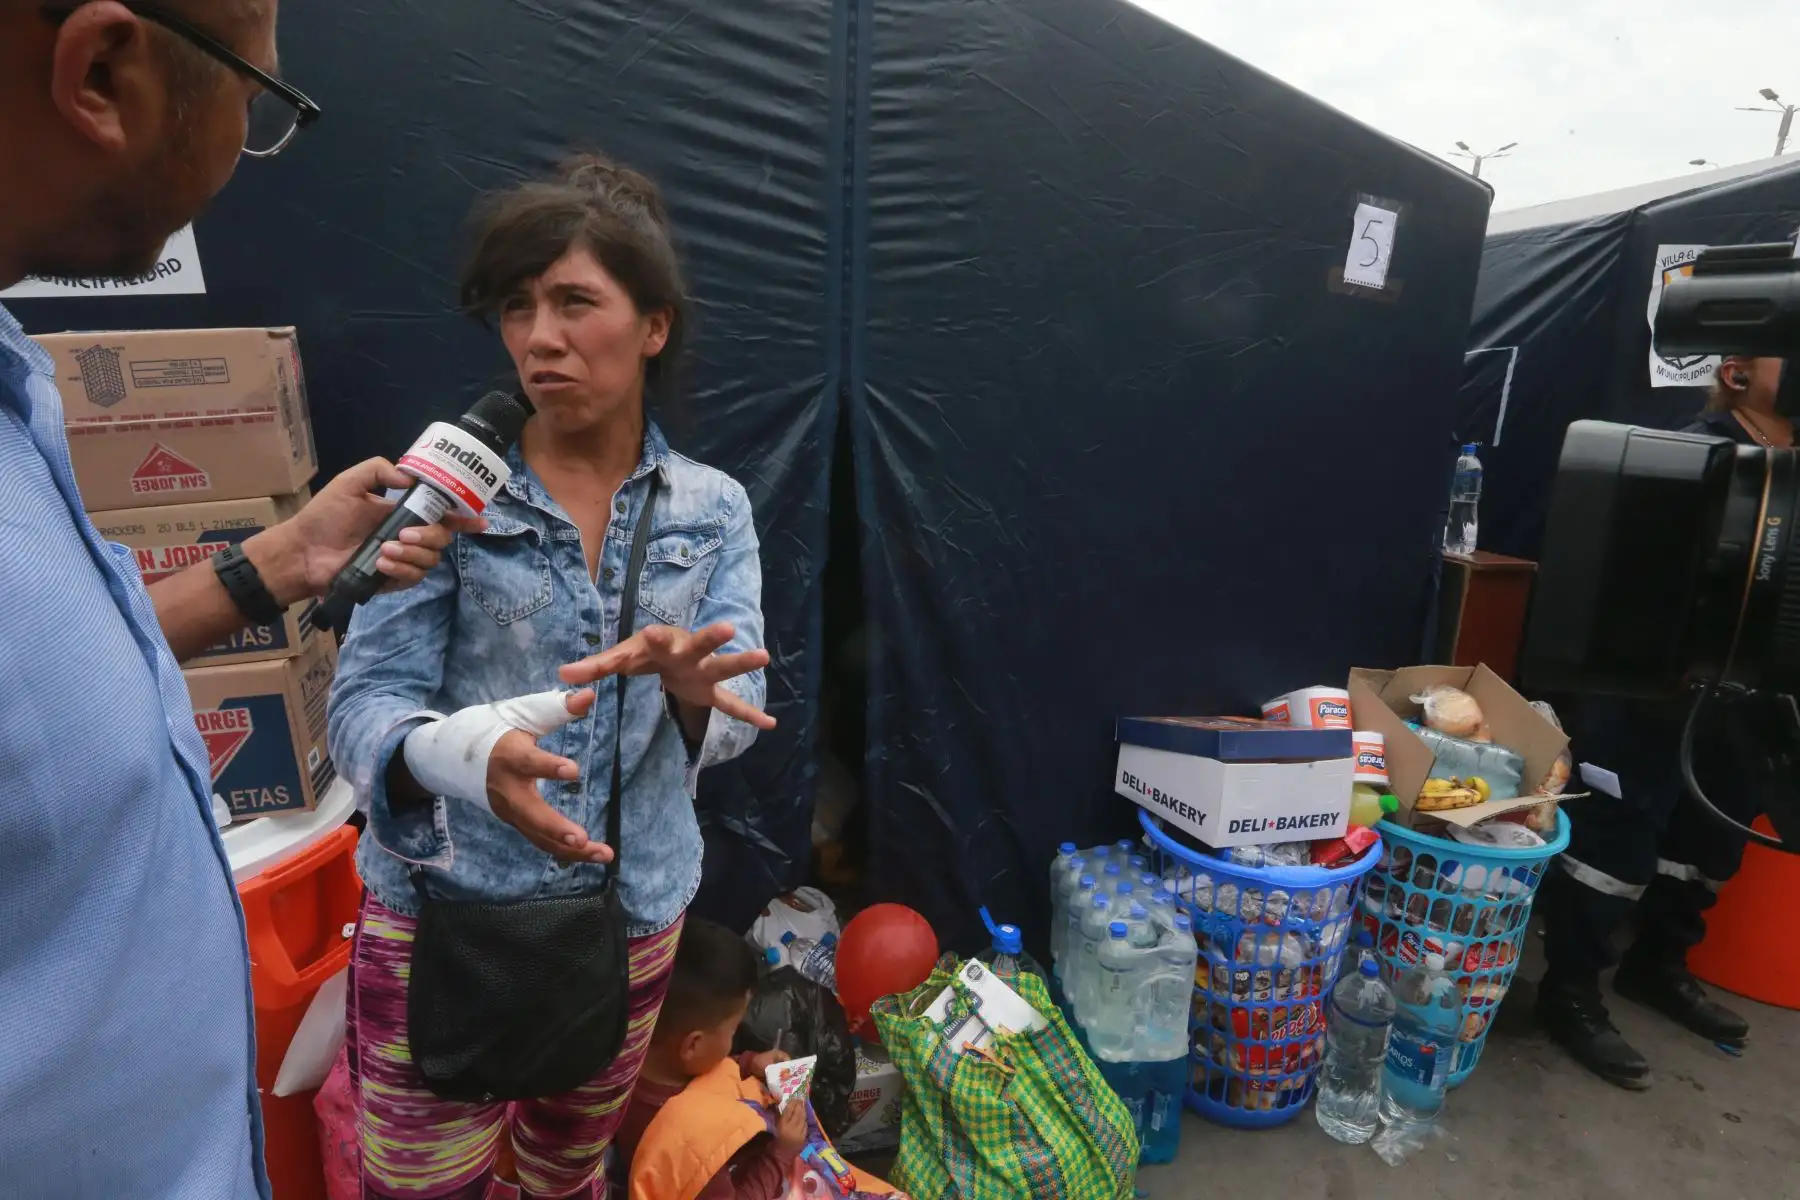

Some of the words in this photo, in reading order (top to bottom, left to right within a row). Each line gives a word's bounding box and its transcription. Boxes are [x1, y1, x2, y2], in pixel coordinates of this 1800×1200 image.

[1358, 219, 1383, 268] 5
[1661, 251, 1684, 268] VILLA
[1686, 249, 1696, 260] EL
[1656, 363, 1713, 383] MUNICIPALIDAD
[434, 437, 498, 488] andina
[132, 477, 178, 493] JORGE
[180, 474, 208, 489] SAN
[98, 524, 146, 537] RACKERS
[1767, 516, 1782, 526] G
[1763, 527, 1779, 552] Lens
[1755, 553, 1777, 581] Sony
[194, 709, 250, 732] ORGE
[229, 785, 290, 810] ETAS
[1122, 770, 1147, 795] DELI
[1152, 787, 1207, 826] BAKERY
[1228, 817, 1268, 834] DELI
[1275, 811, 1341, 831] BAKERY
[1389, 1047, 1413, 1068] ARLOS
